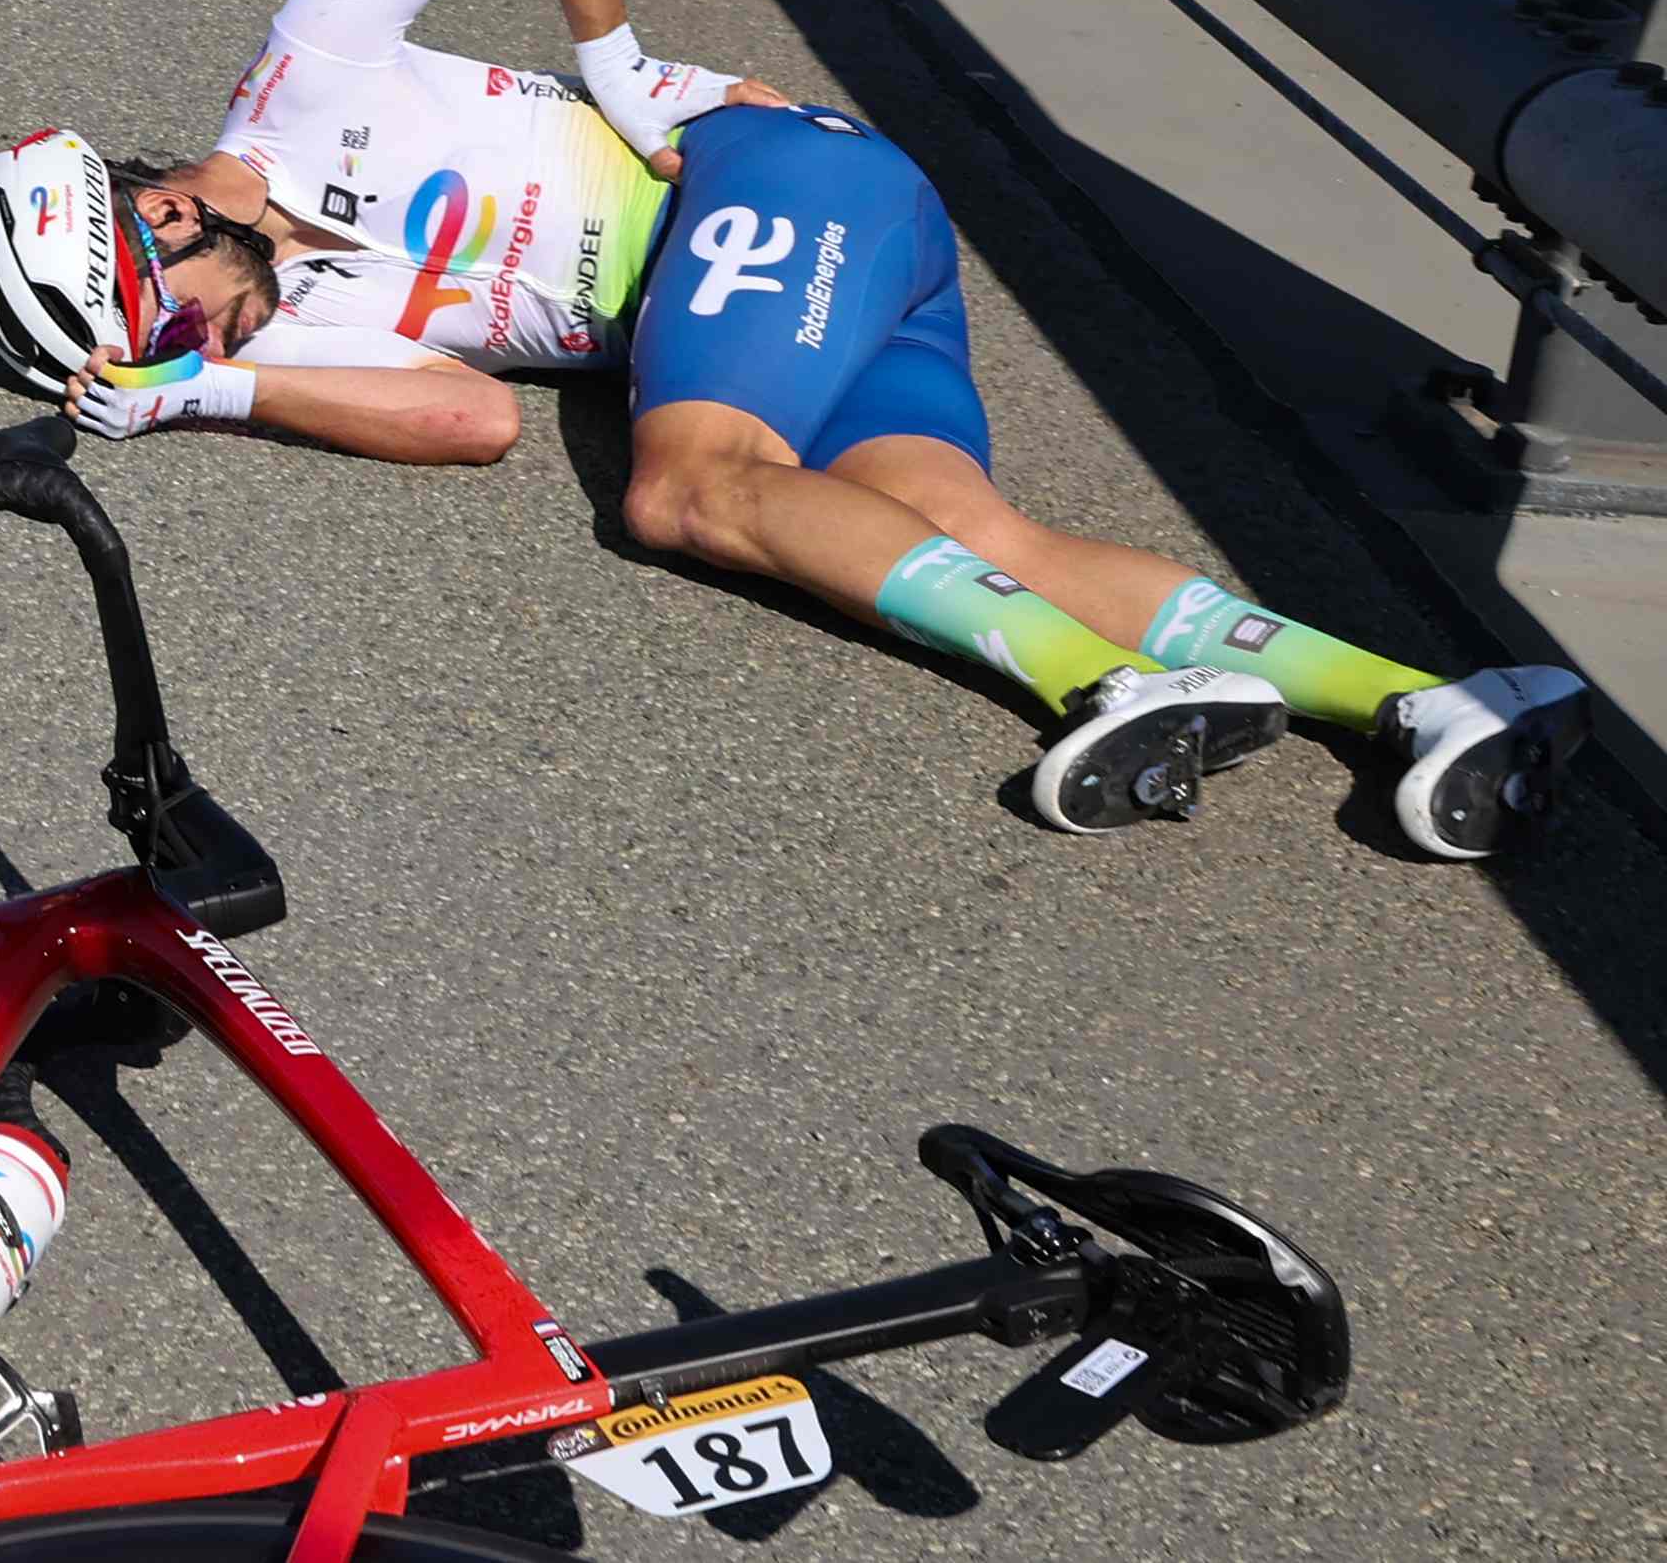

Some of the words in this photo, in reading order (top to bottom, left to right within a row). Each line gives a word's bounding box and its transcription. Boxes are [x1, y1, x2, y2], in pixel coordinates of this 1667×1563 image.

[249, 53, 295, 125] TotalEnergies
[82, 153, 109, 319] SPECIALIZED
[485, 181, 543, 352] TotalEnergies
[794, 220, 846, 350] TotalEnergies
[175, 929, 322, 1058] SPECIALIZED
[442, 1398, 593, 1442] TARMAC
[609, 1385, 768, 1440] Continental
[641, 1416, 814, 1510] 187
